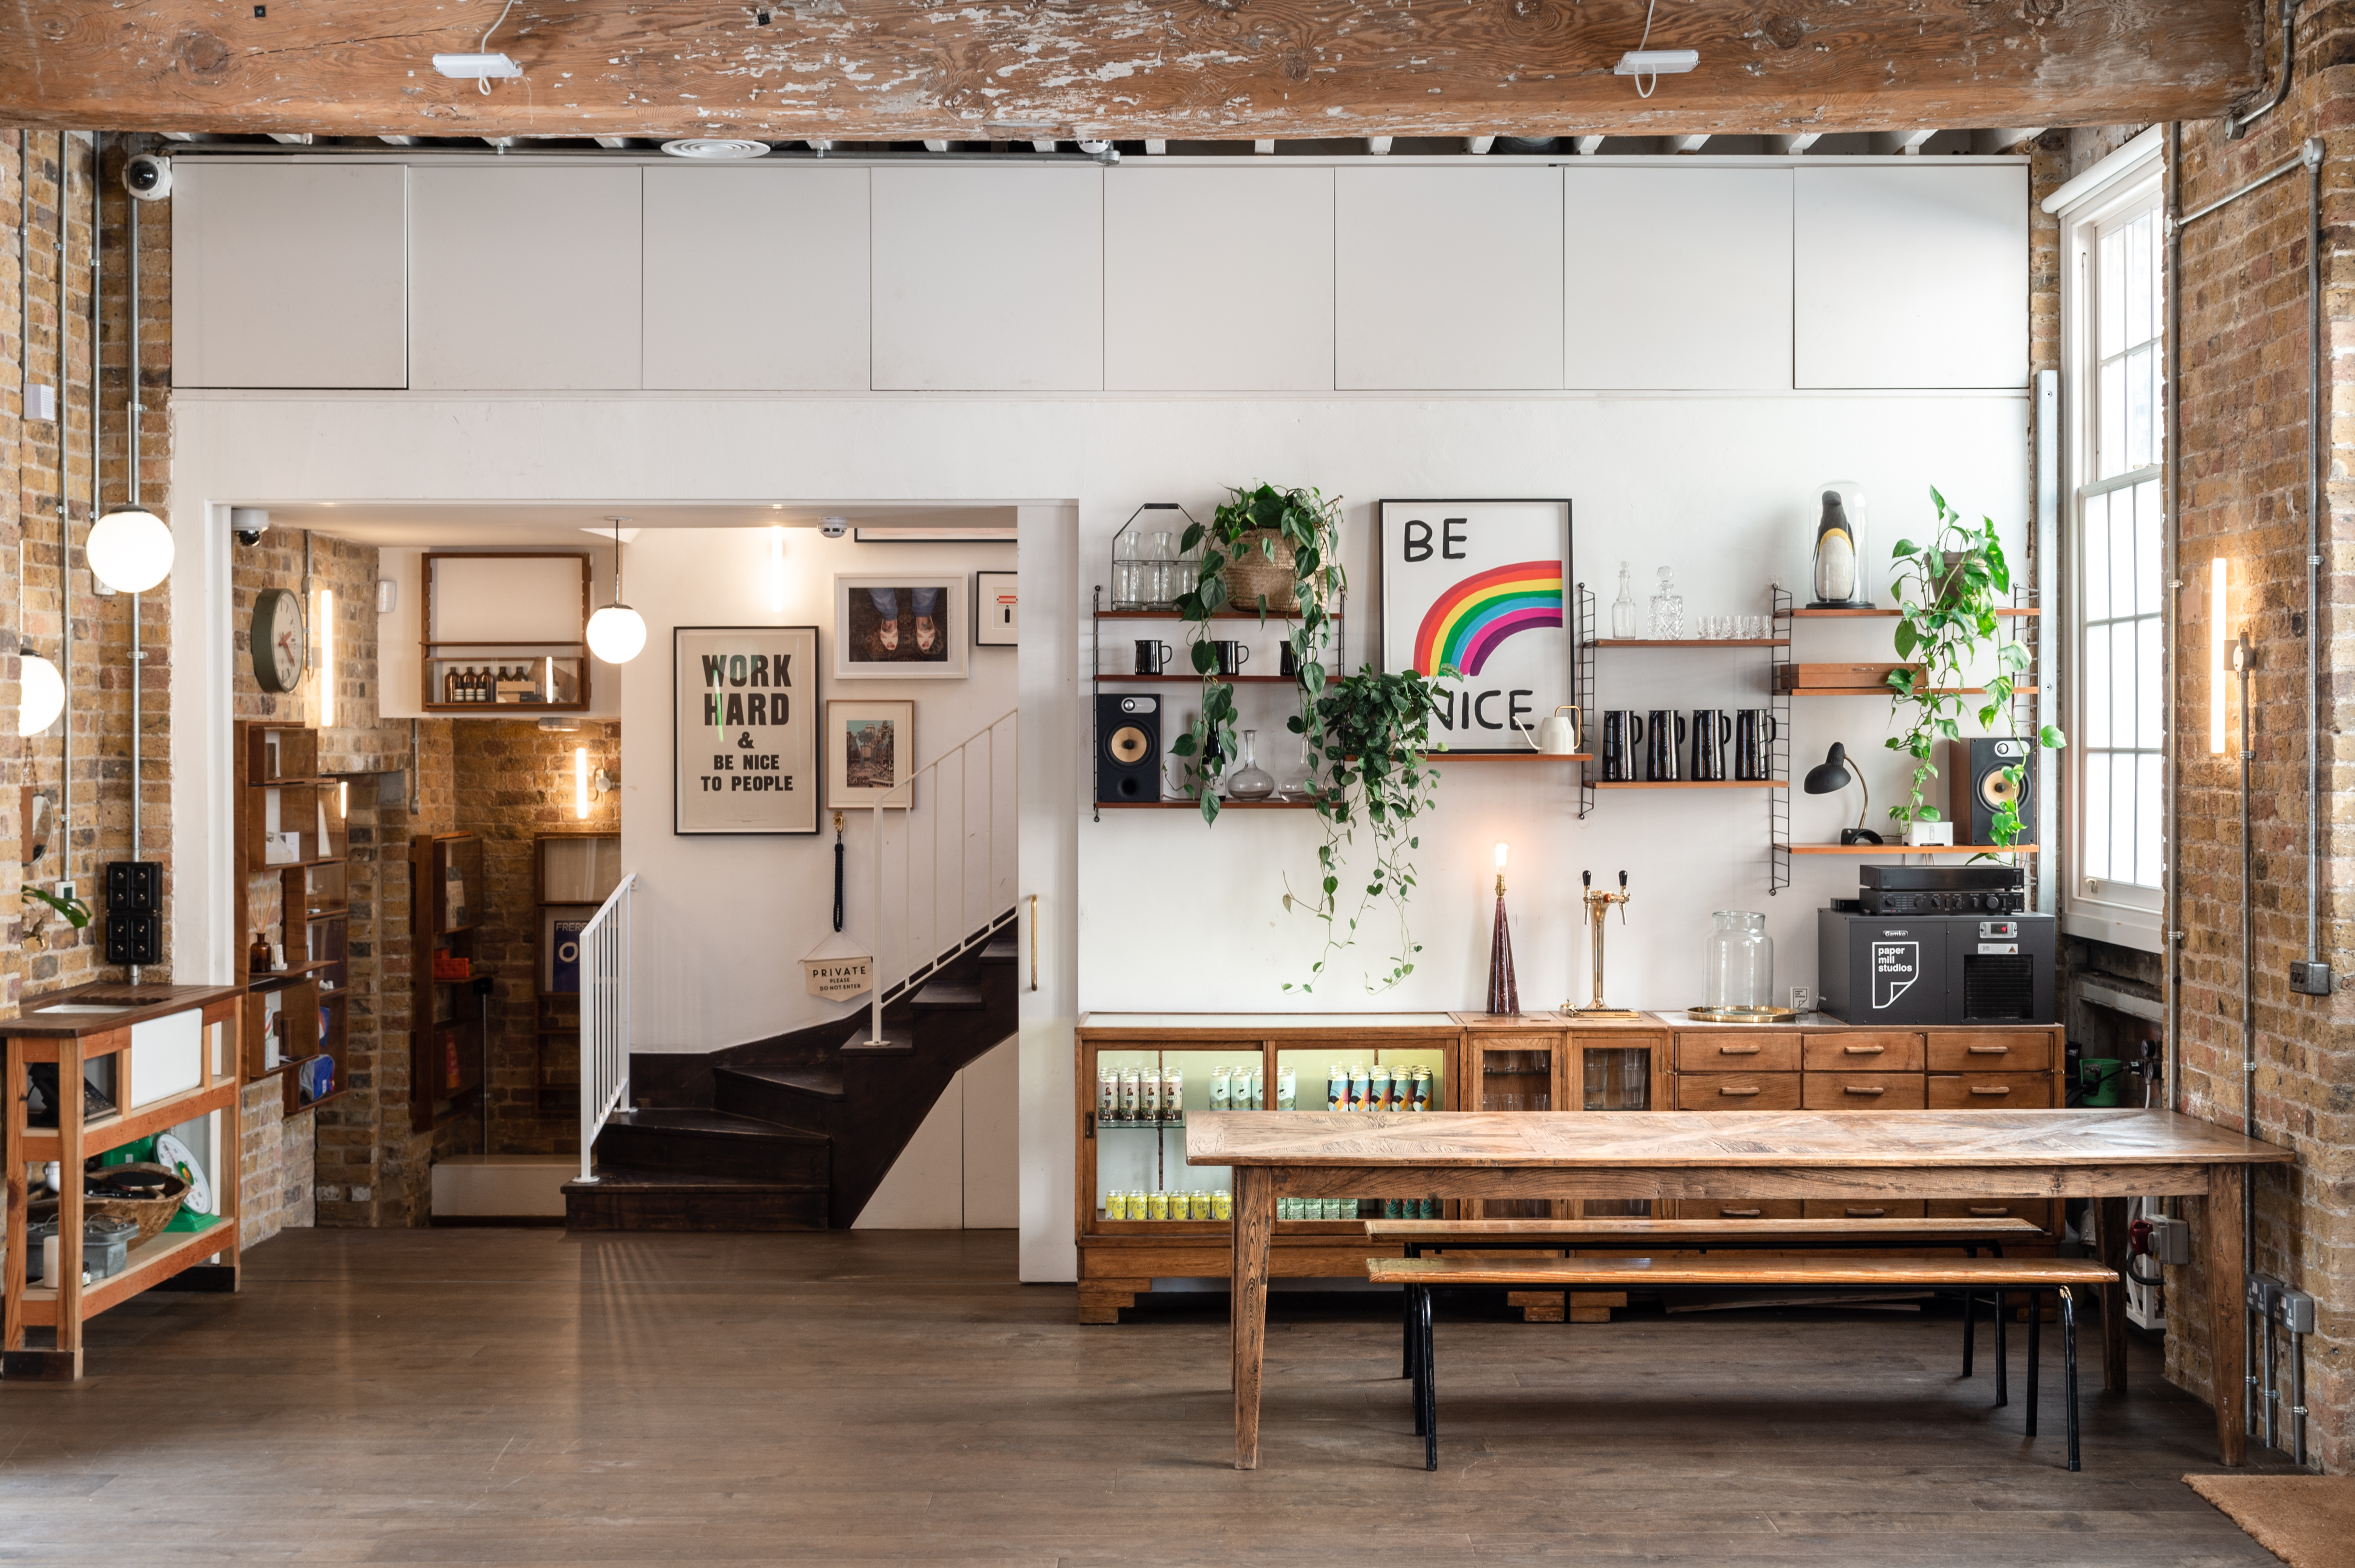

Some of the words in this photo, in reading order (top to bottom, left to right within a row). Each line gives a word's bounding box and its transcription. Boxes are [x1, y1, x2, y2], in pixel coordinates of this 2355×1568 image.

[1404, 518, 1468, 562] BE
[701, 654, 792, 687] WORK
[704, 693, 789, 726] HARD
[1426, 689, 1535, 731] NICE
[737, 731, 755, 749] &
[714, 754, 734, 770] BE
[743, 754, 780, 770] NICE
[701, 776, 722, 792] TO
[731, 775, 793, 791] PEOPLE
[1878, 947, 1905, 956] paper
[1878, 955, 1895, 964] mill
[813, 966, 866, 978] PRIVATE
[1878, 963, 1912, 972] studios
